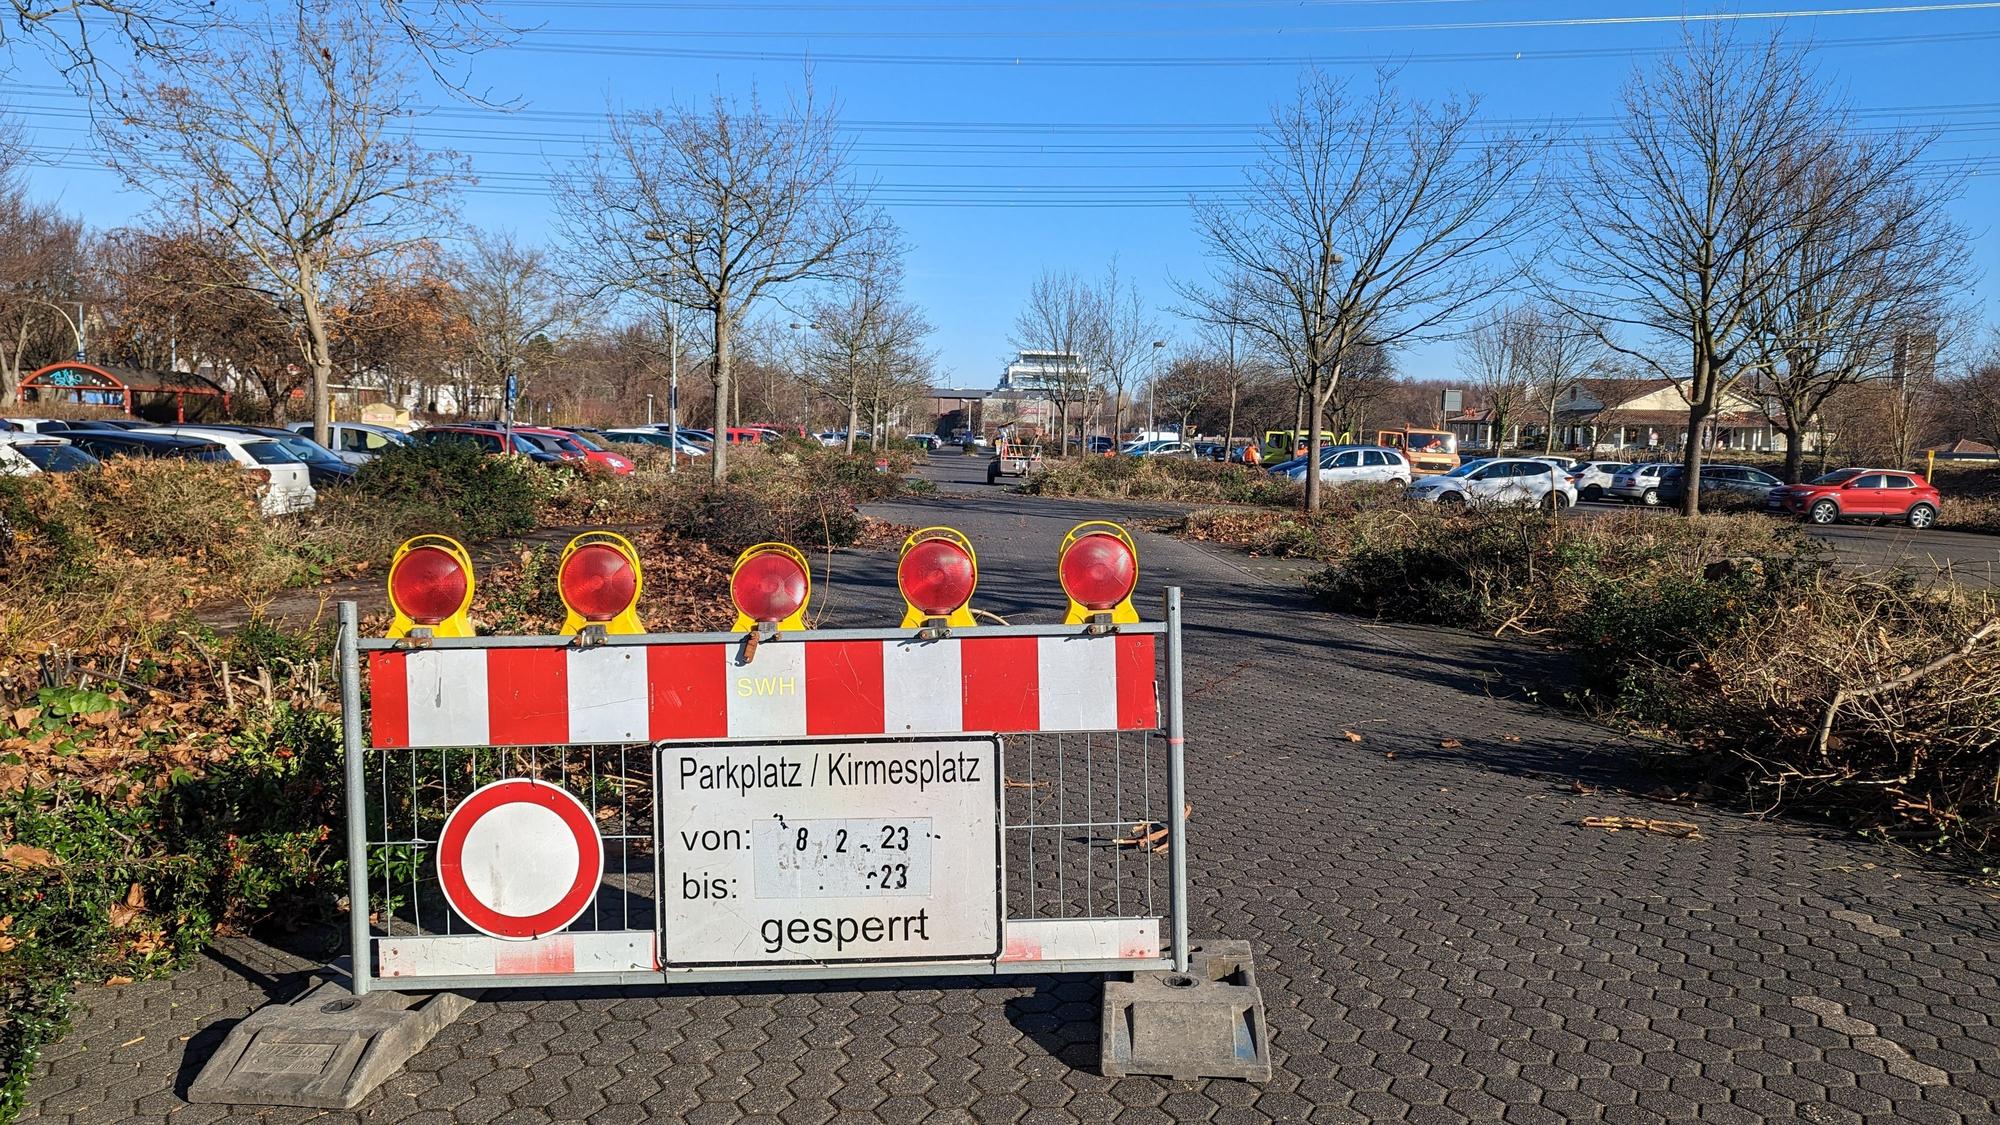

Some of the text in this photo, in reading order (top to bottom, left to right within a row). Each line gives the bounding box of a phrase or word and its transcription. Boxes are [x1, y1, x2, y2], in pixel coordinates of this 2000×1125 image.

[737, 676, 795, 697] SWH
[680, 755, 802, 797] Parkplatz
[828, 750, 981, 792] Kirmesplatz
[680, 828, 751, 851] von:
[682, 871, 738, 900] bis:
[760, 908, 930, 953] gesperrt
